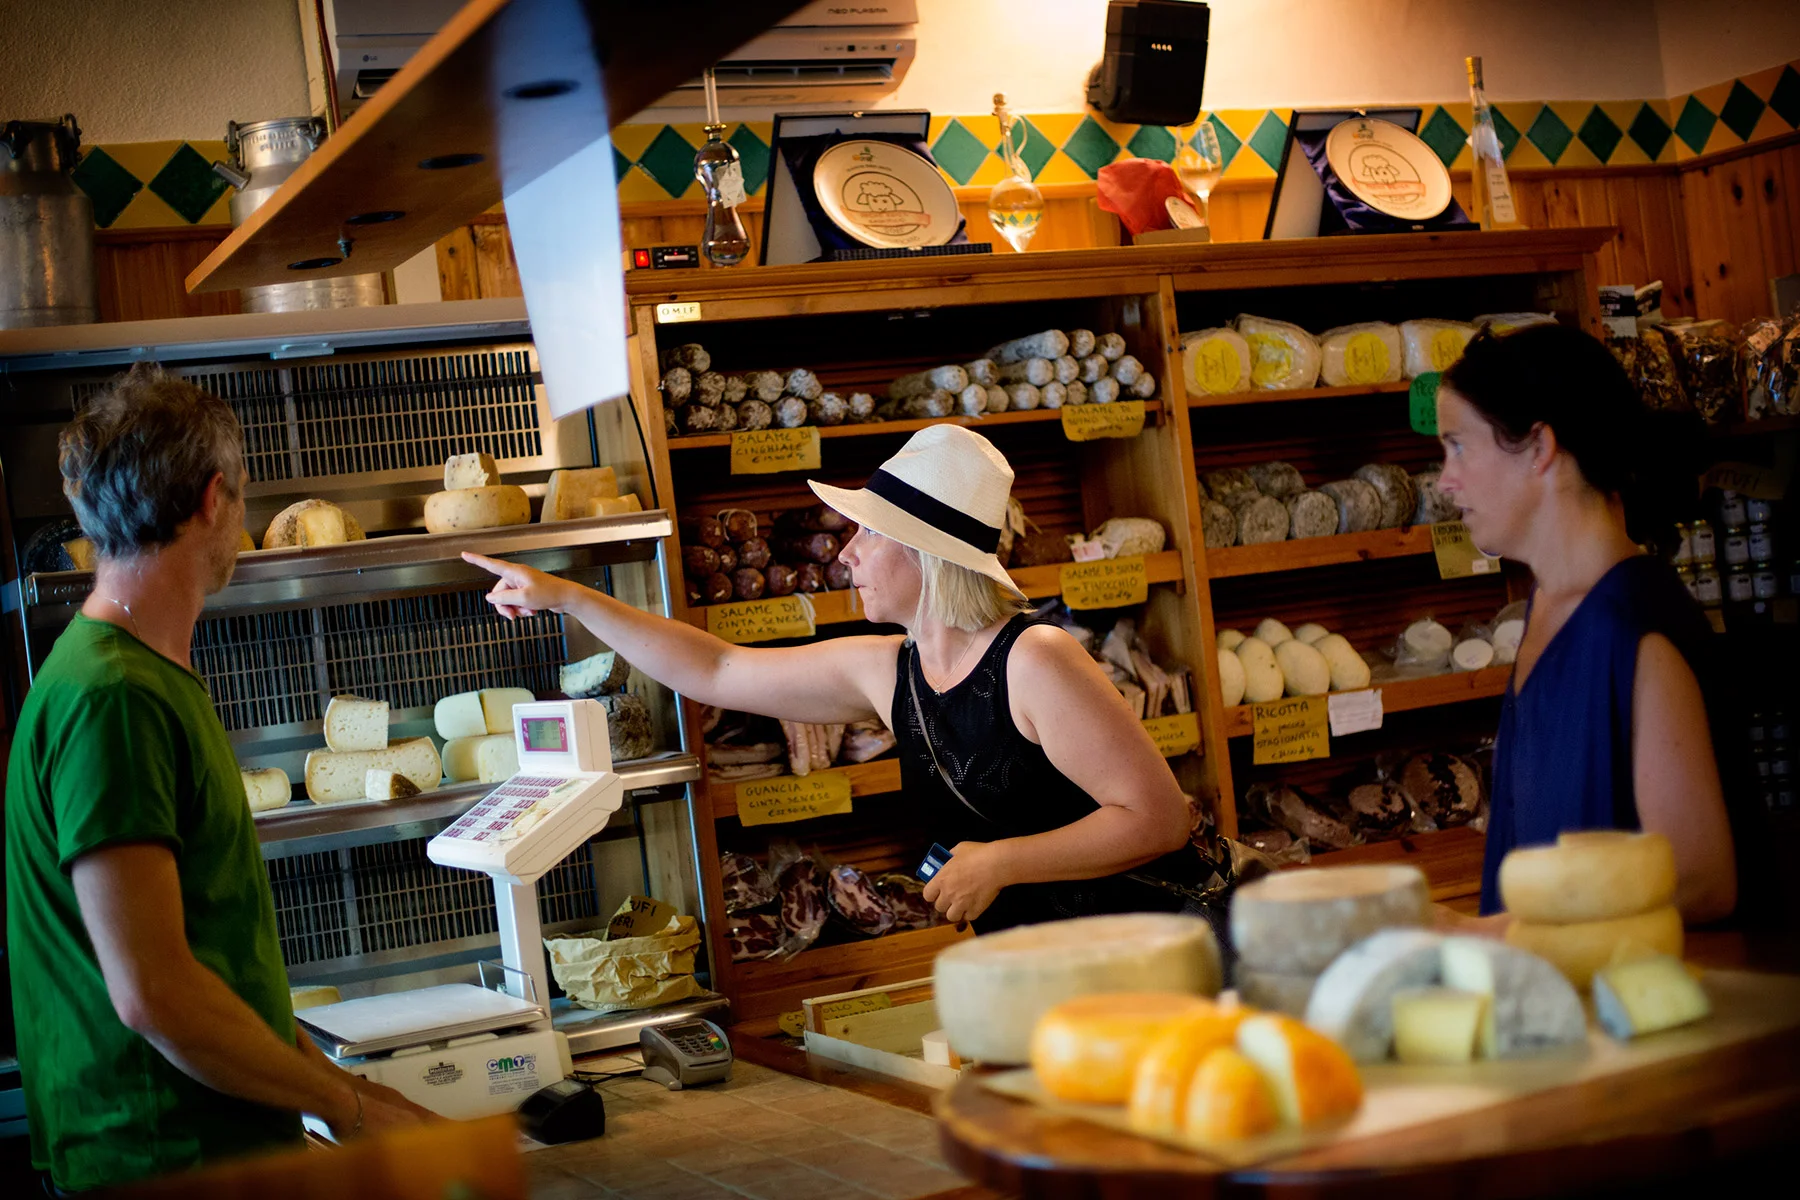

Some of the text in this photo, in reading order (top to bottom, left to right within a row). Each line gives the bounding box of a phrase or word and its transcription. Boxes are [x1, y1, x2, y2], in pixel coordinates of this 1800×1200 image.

[738, 430, 812, 444] SALAME DI
[736, 443, 803, 455] CINGHIALE
[1066, 567, 1100, 579] SALAME
[1116, 563, 1144, 574] SUINO
[1082, 576, 1138, 591] FINOCCHIO
[720, 602, 797, 618] SALAME DI
[717, 615, 804, 630] CINTA SENESE
[1256, 700, 1309, 720] RICOTTA
[1256, 731, 1320, 749] STAGIONATA
[746, 782, 825, 796] GUANCIA DI
[749, 792, 830, 808] CINTA SENESE
